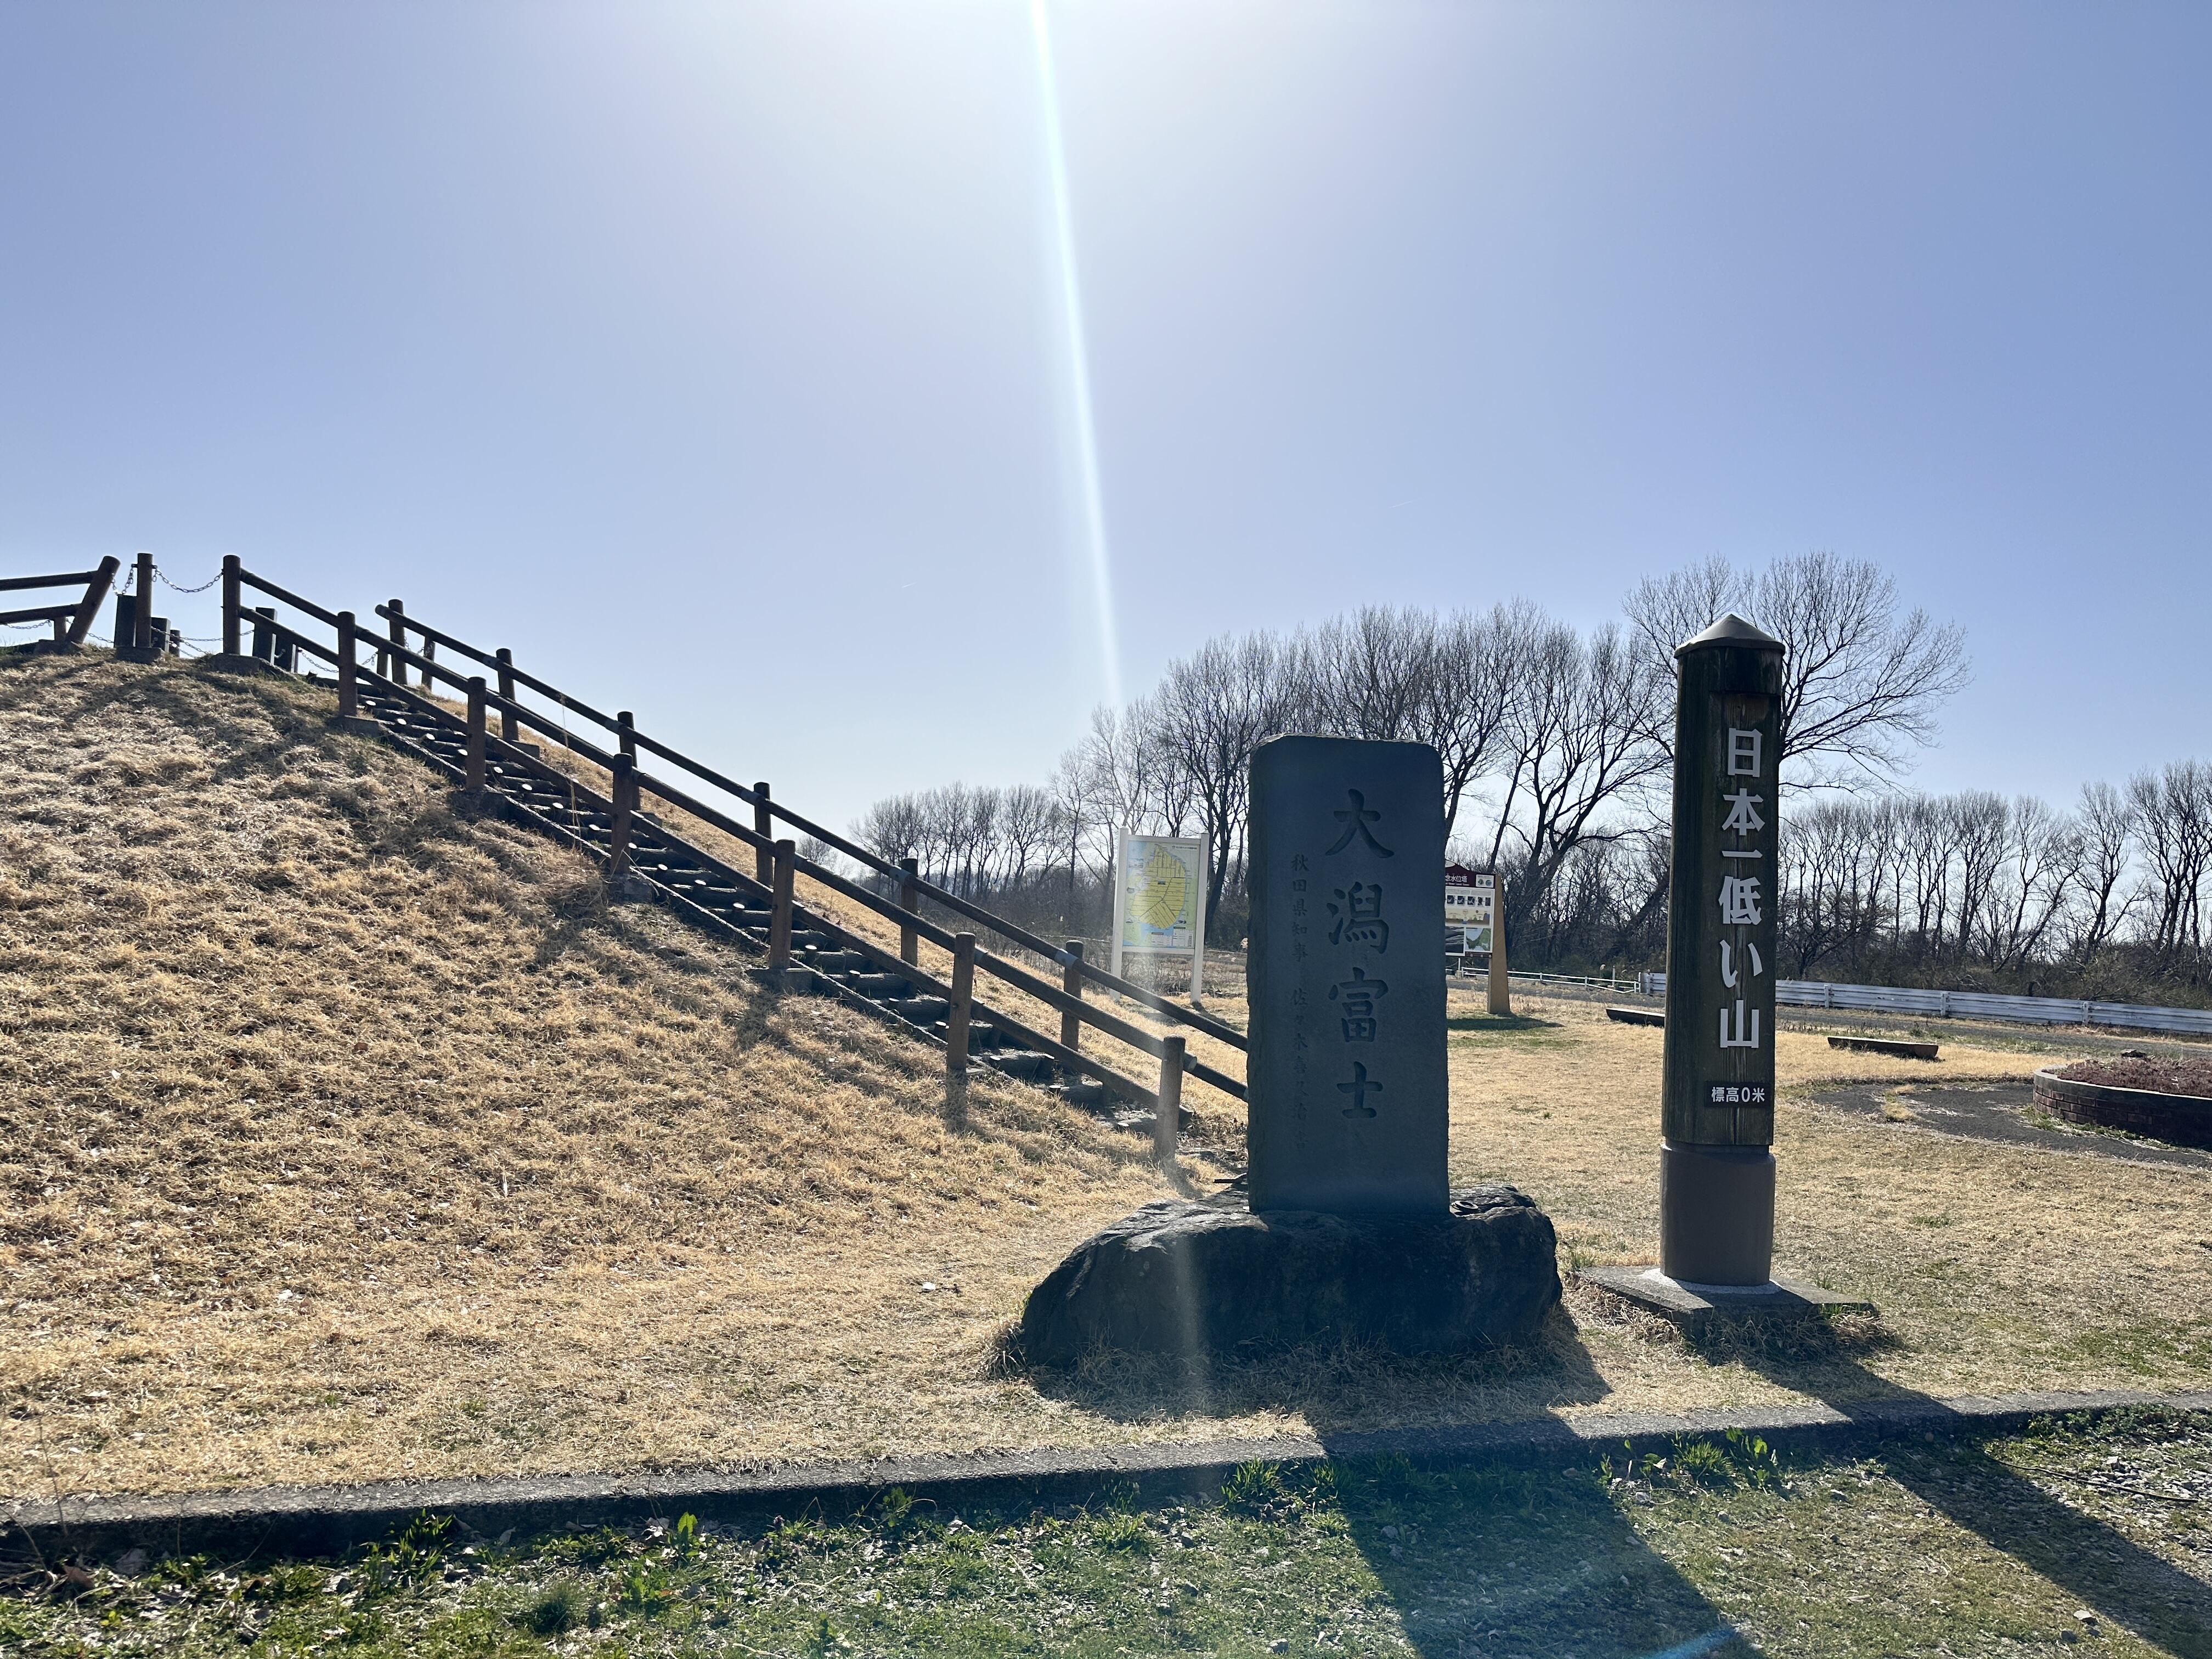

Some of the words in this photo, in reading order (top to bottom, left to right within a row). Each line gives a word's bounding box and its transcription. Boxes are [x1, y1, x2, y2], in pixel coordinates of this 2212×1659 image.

[1290, 854, 1310, 962] 秋田県知事
[1325, 788, 1395, 1119] 大潟富士
[1719, 728, 1765, 1048] 日本一低い山
[1712, 1087, 1765, 1103] 標高0米
